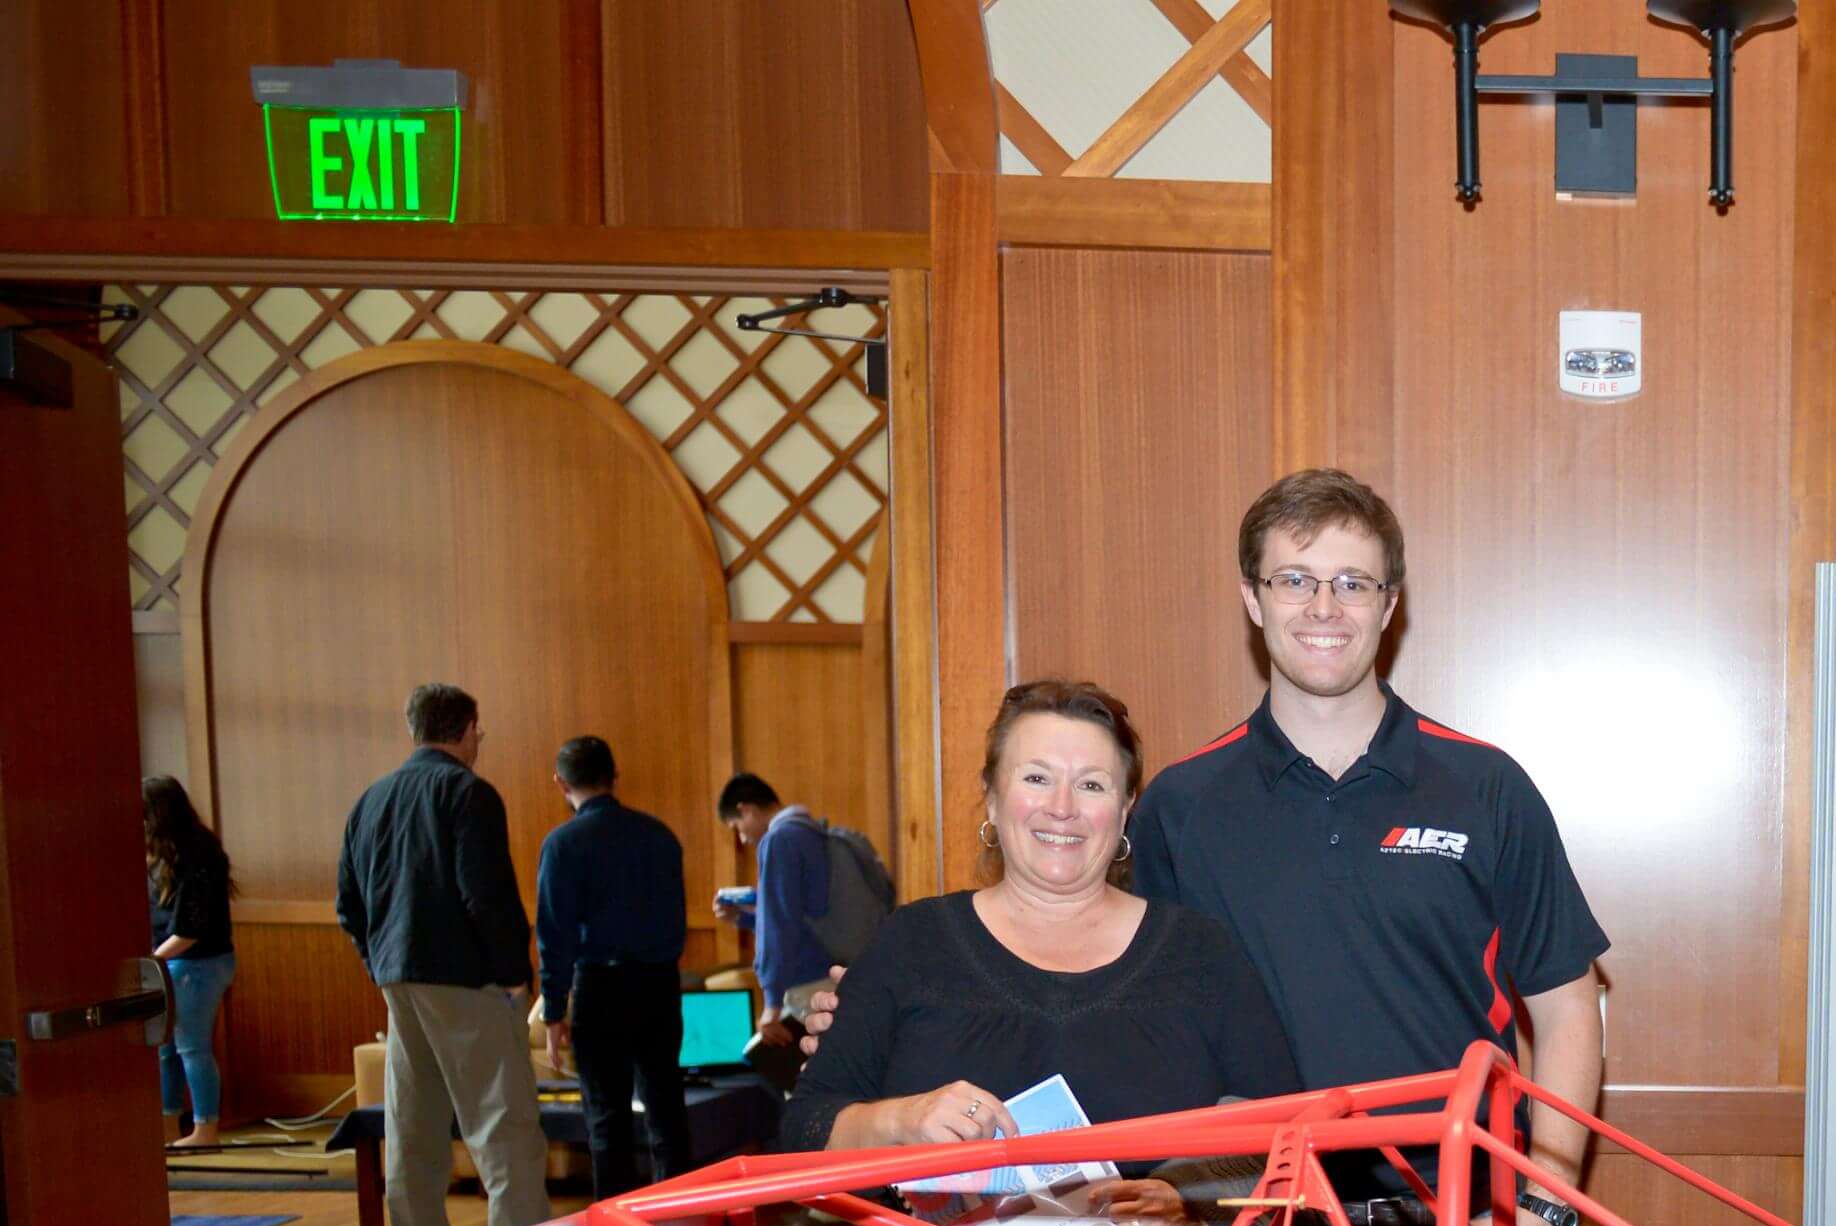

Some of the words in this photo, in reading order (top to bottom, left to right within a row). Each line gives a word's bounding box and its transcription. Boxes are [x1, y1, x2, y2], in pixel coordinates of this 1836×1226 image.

[308, 118, 426, 211] EXIT
[1581, 382, 1617, 393] FIRE
[1395, 828, 1469, 853] AER
